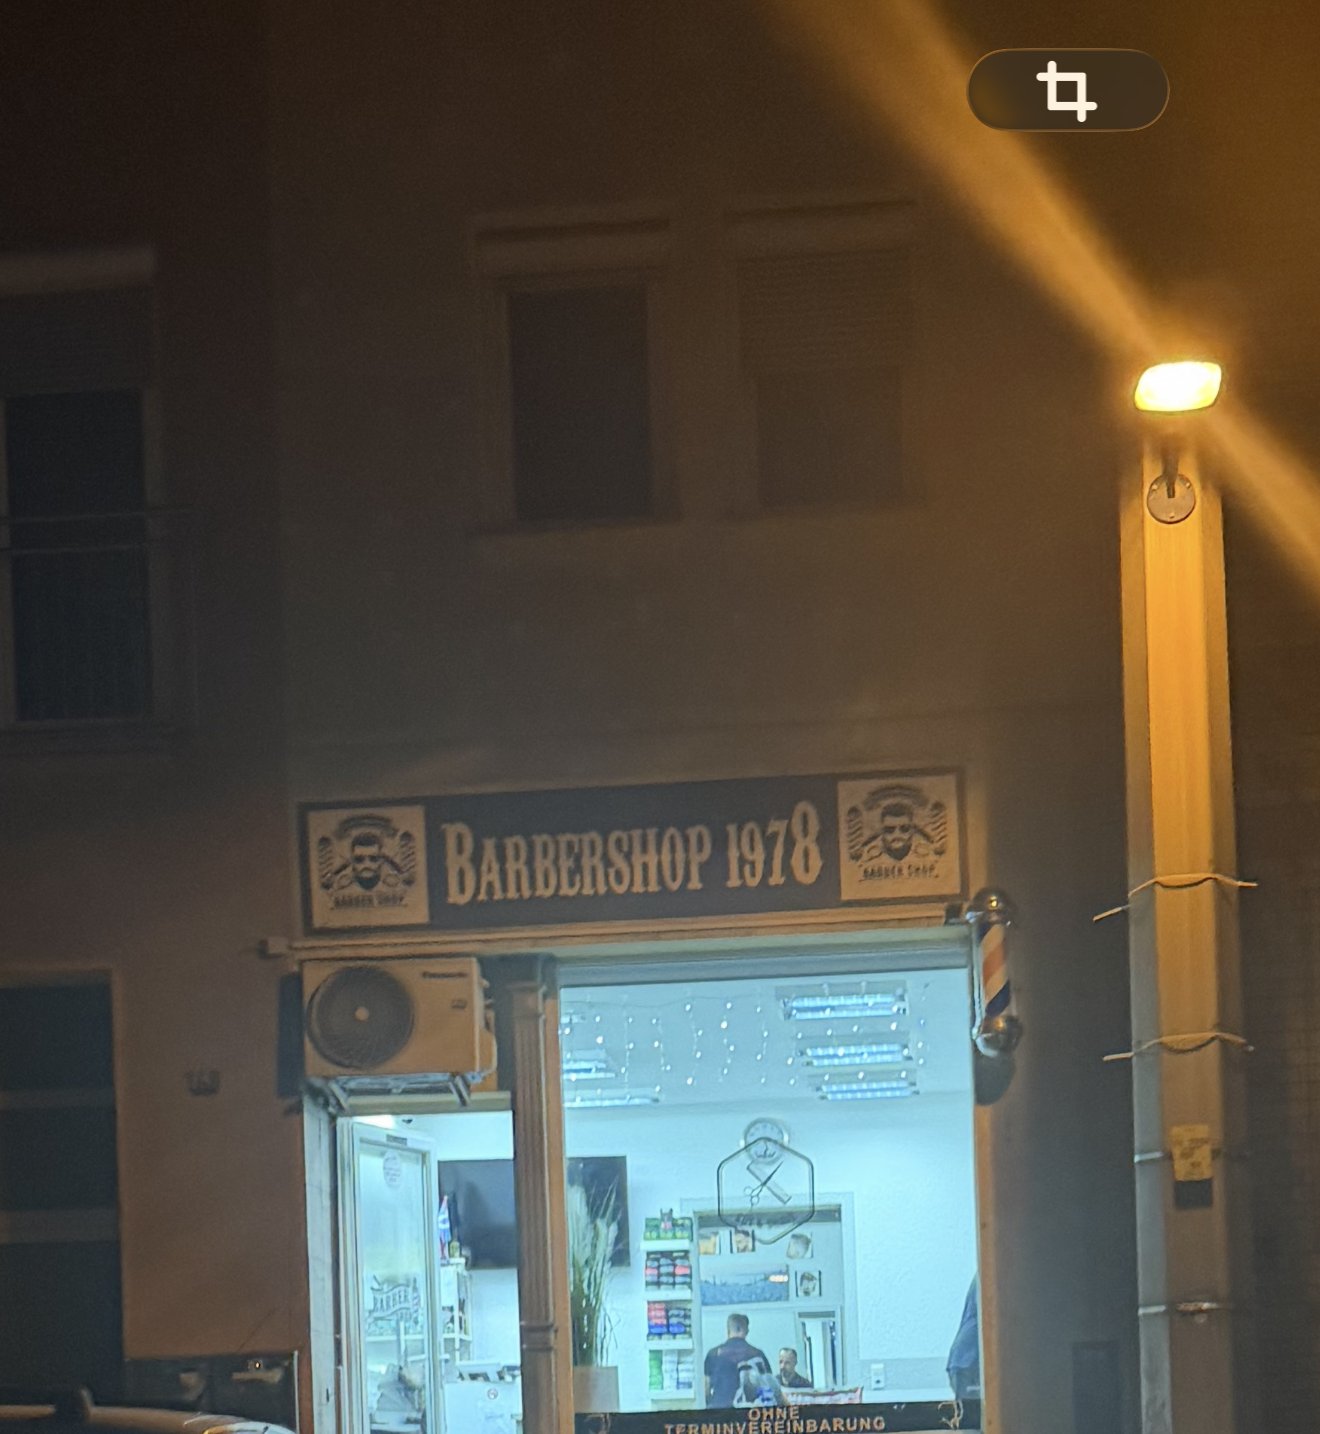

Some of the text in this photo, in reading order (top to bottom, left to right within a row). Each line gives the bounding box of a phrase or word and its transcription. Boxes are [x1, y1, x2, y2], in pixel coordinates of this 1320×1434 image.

[441, 801, 823, 906] BARBERSHOP 1978
[748, 1405, 800, 1421] OHNE
